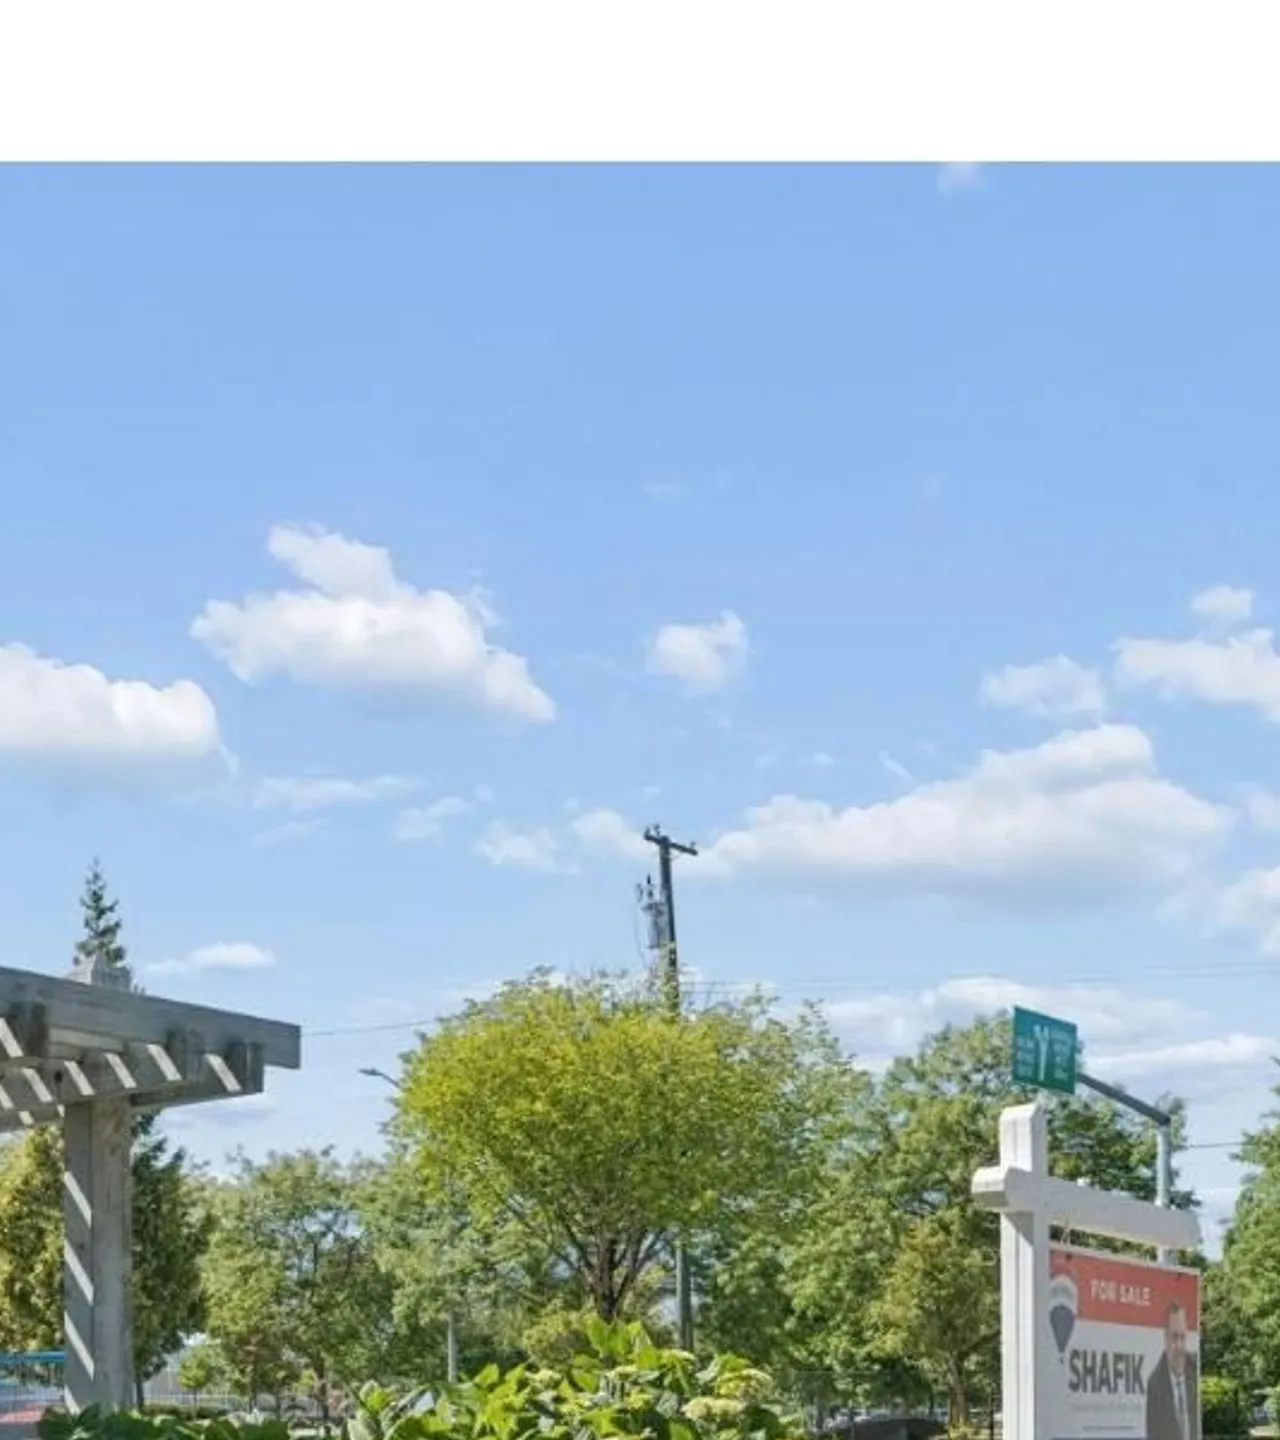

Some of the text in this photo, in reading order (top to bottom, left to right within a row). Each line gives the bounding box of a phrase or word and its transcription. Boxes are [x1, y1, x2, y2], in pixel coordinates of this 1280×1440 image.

[1090, 1278, 1117, 1302] FOR
[1120, 1284, 1151, 1306] SALE
[1068, 1349, 1146, 1395] SHAFIK
